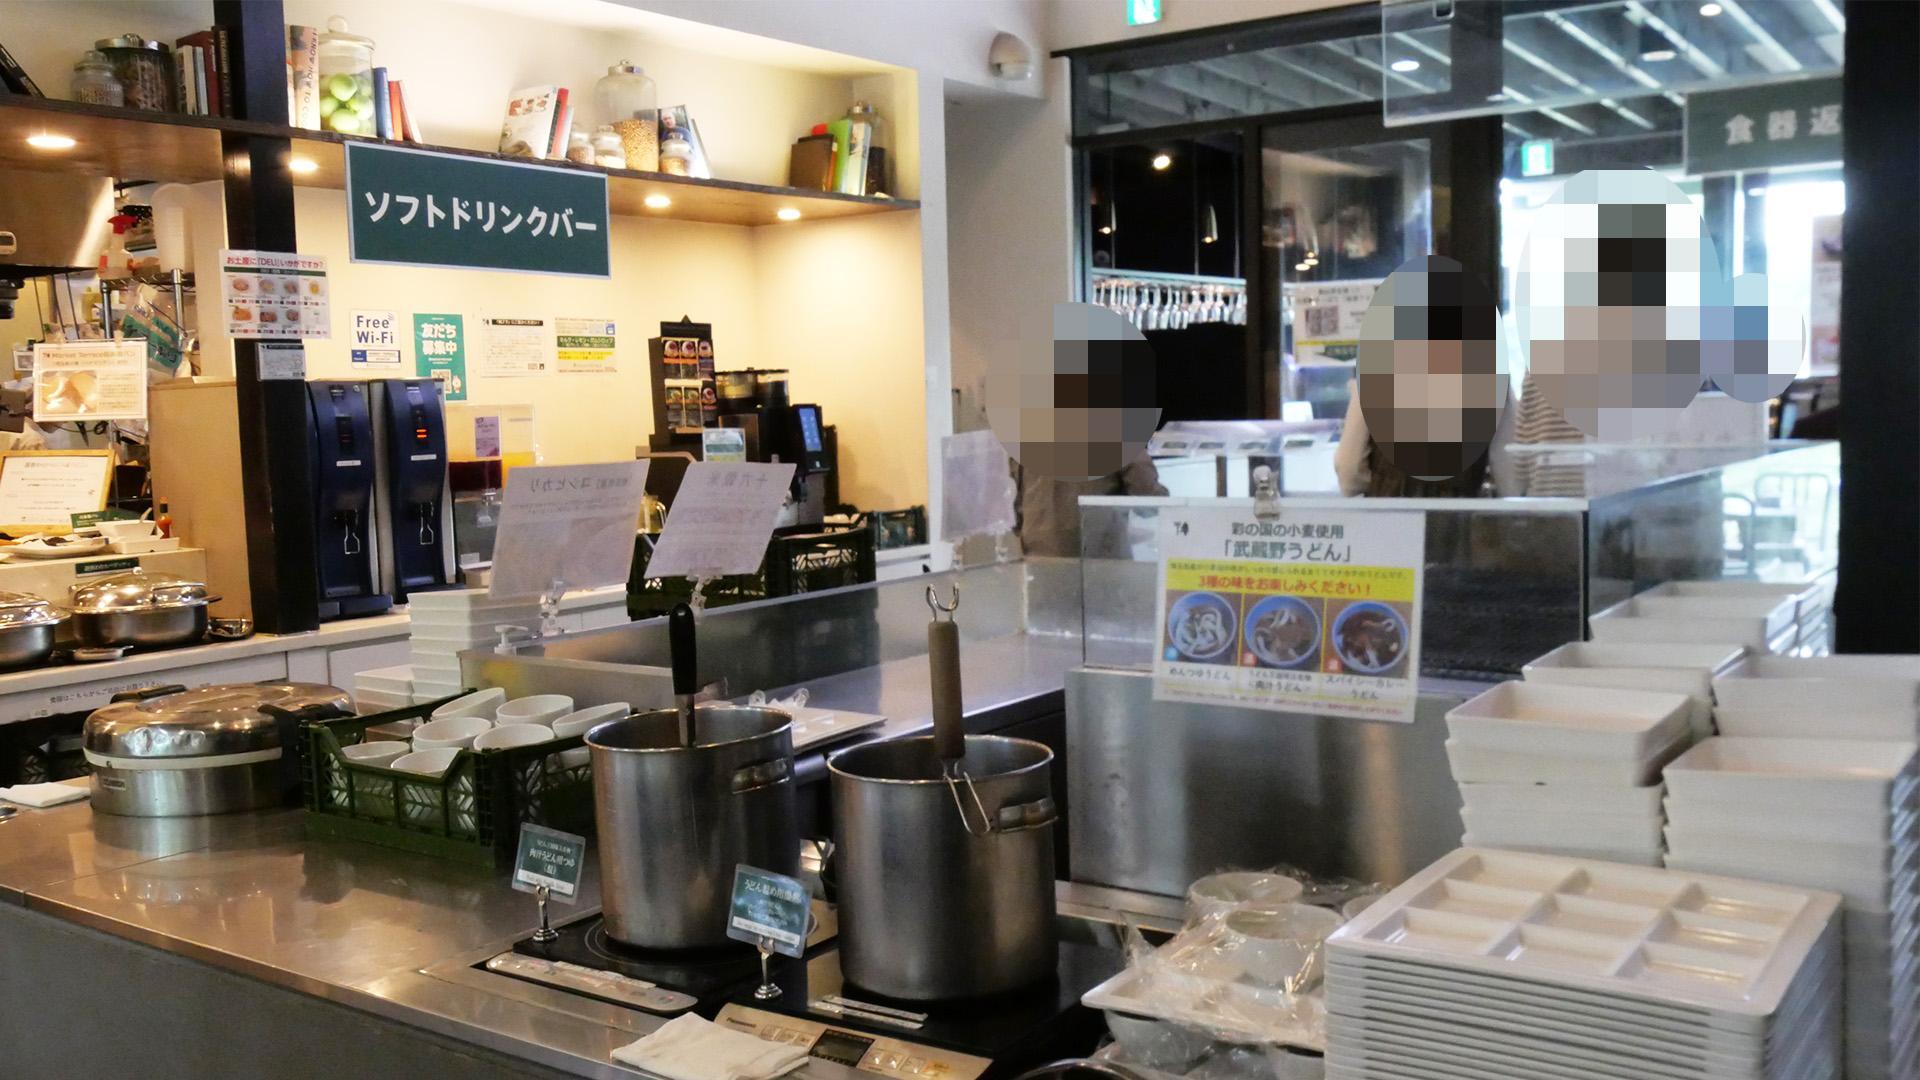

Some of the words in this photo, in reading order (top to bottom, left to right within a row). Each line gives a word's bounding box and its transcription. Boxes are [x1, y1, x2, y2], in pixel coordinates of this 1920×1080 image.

[1725, 103, 1843, 145] 食器返
[365, 190, 597, 238] ソフトドリンクバー
[356, 315, 390, 328] Free
[356, 331, 394, 344] Wi-Fi
[421, 323, 457, 339] 友だち
[422, 340, 458, 356] 募集中
[1231, 522, 1345, 539] 彩の国の小麦使用
[1224, 539, 1352, 562] 「武蔵野うどん」
